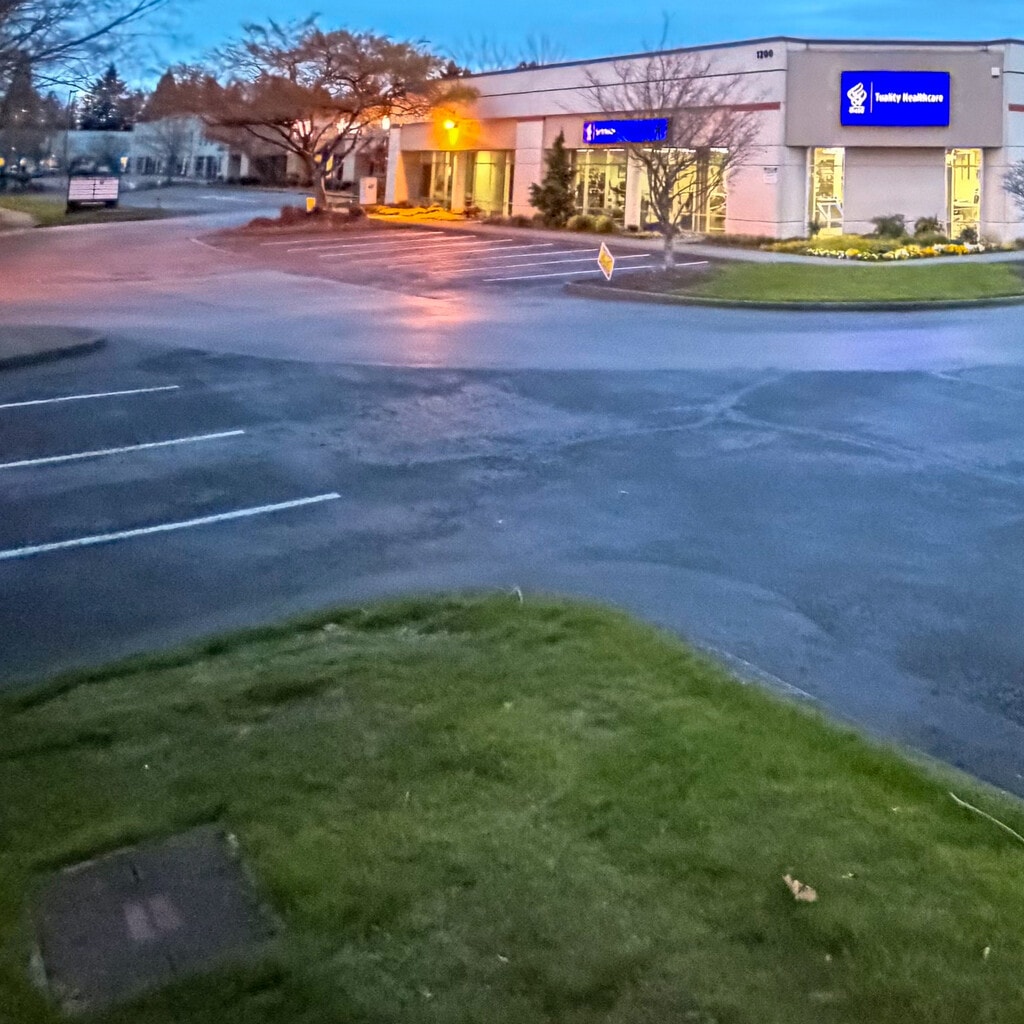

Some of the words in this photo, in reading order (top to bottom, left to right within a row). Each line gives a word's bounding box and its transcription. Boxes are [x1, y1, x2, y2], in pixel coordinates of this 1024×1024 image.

[756, 49, 774, 59] 1200
[875, 92, 901, 104] Tuality
[902, 92, 944, 103] Healthcare
